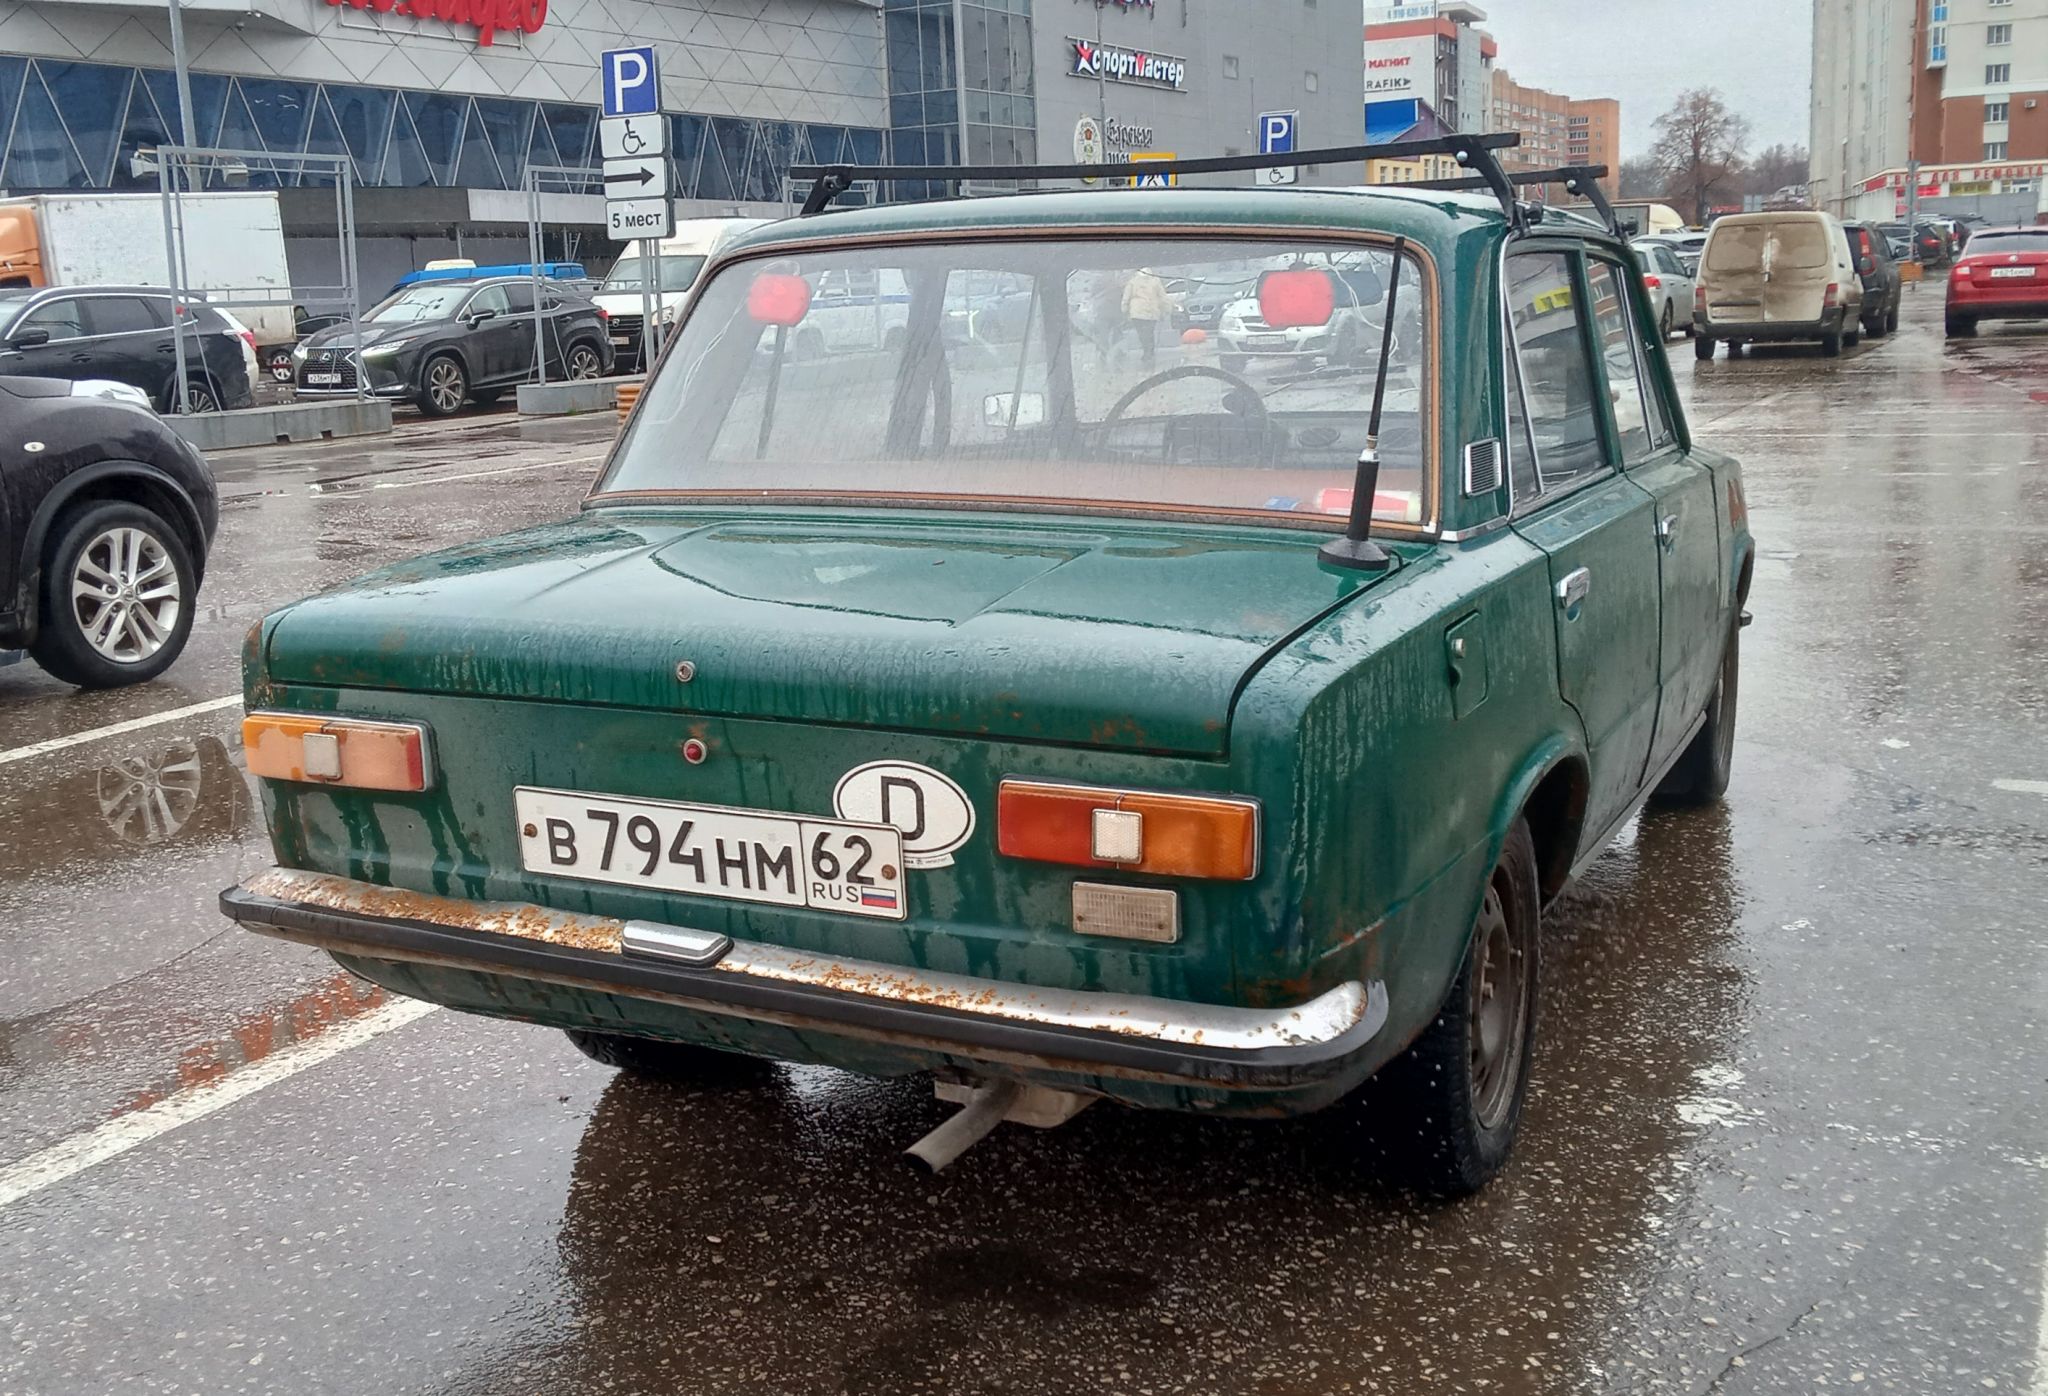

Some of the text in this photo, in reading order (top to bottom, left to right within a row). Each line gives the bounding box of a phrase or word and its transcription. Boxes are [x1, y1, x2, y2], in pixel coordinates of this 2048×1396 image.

[1368, 56, 1411, 69] МАГНИТ
[613, 52, 648, 113] P
[1266, 117, 1289, 153] P
[1973, 165, 2044, 181] РЕМОНТА
[612, 212, 662, 229] 5 мест
[880, 776, 925, 841] D
[811, 831, 875, 886] 62
[812, 881, 860, 903] RUS
